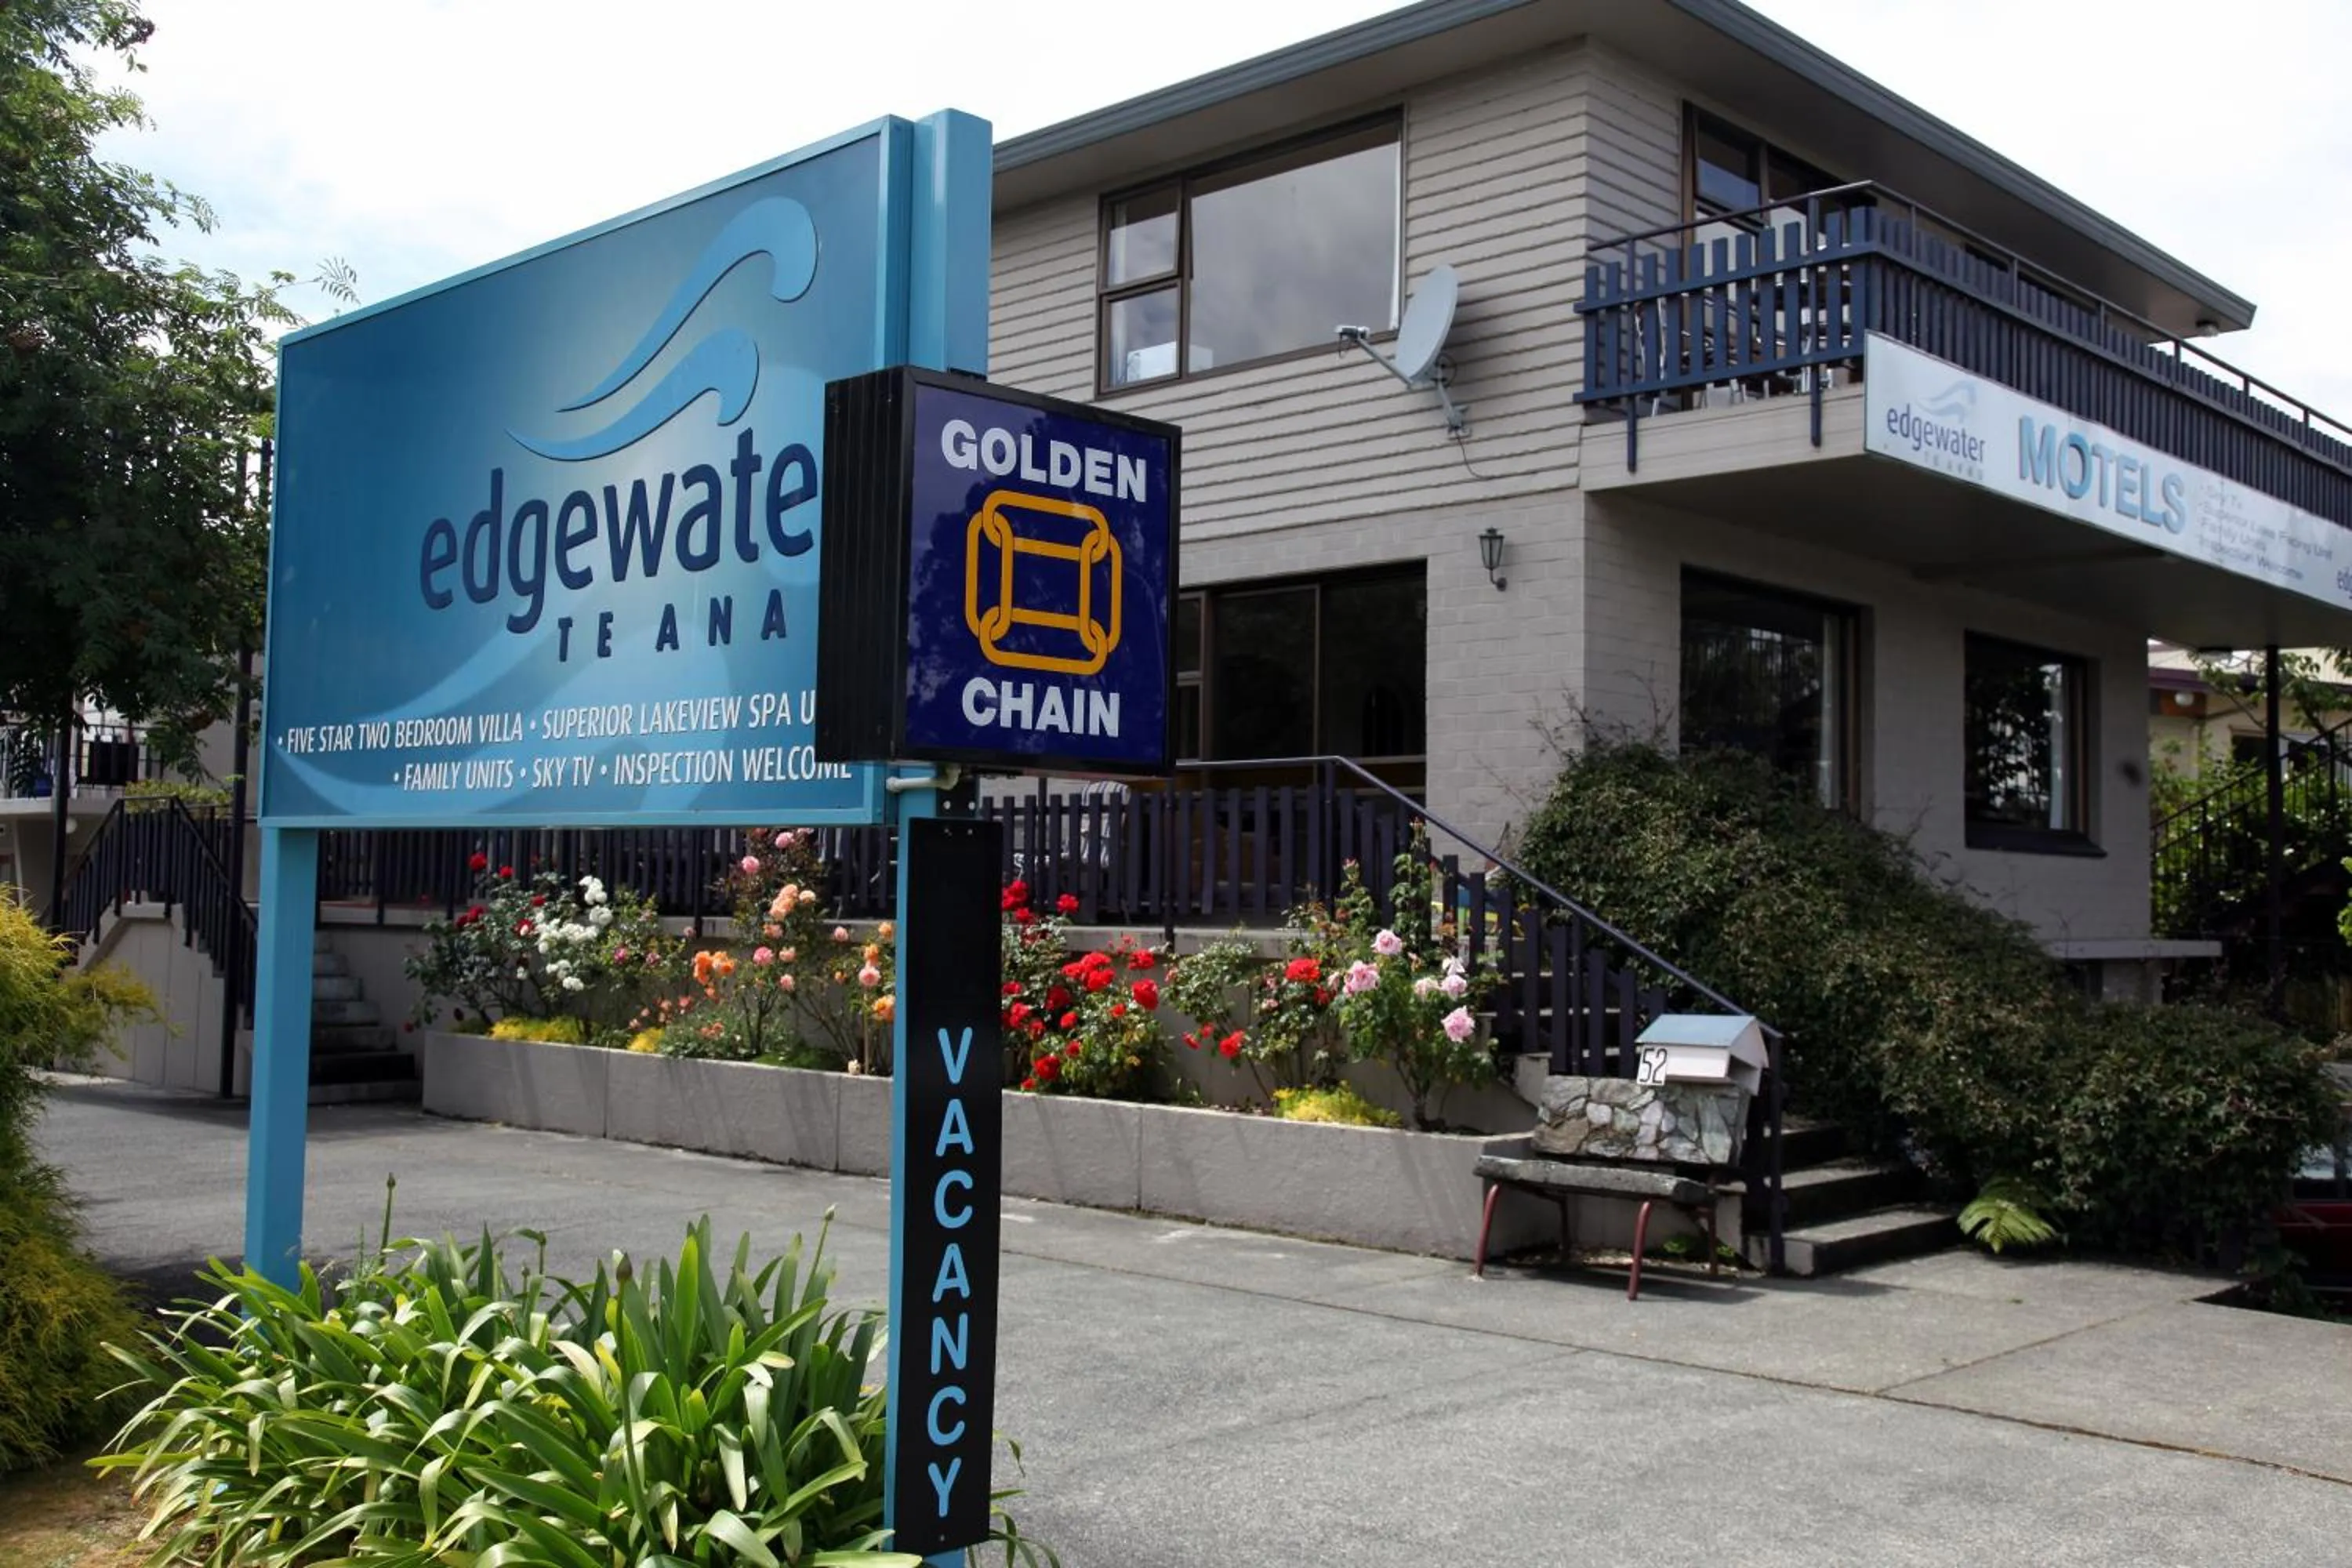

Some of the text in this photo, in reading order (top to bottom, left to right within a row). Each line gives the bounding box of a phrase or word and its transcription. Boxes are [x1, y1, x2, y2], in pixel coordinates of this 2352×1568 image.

[941, 419, 1147, 503] GOLDEN
[1886, 402, 1986, 463] edgewater
[2019, 414, 2186, 535] MOTELS
[419, 427, 818, 633] edgewate
[557, 589, 787, 662] TE ANA
[287, 728, 315, 754] FIVE
[318, 724, 354, 753] STAR
[358, 720, 390, 750] TWO
[394, 716, 472, 750] BEDROOM
[478, 712, 524, 743] VILLA
[542, 703, 633, 741] SUPERIOR
[639, 695, 742, 735] LAKEVIEW
[748, 691, 792, 728] SPA
[962, 677, 1120, 738] CHAIN
[403, 760, 463, 791] FAMILY
[466, 758, 514, 789] UNITS
[532, 756, 568, 788] SKY
[572, 755, 596, 787] TV
[614, 749, 735, 785] INSPECTION
[1639, 1047, 1668, 1084] 52
[927, 1026, 974, 1517] VACANCY
